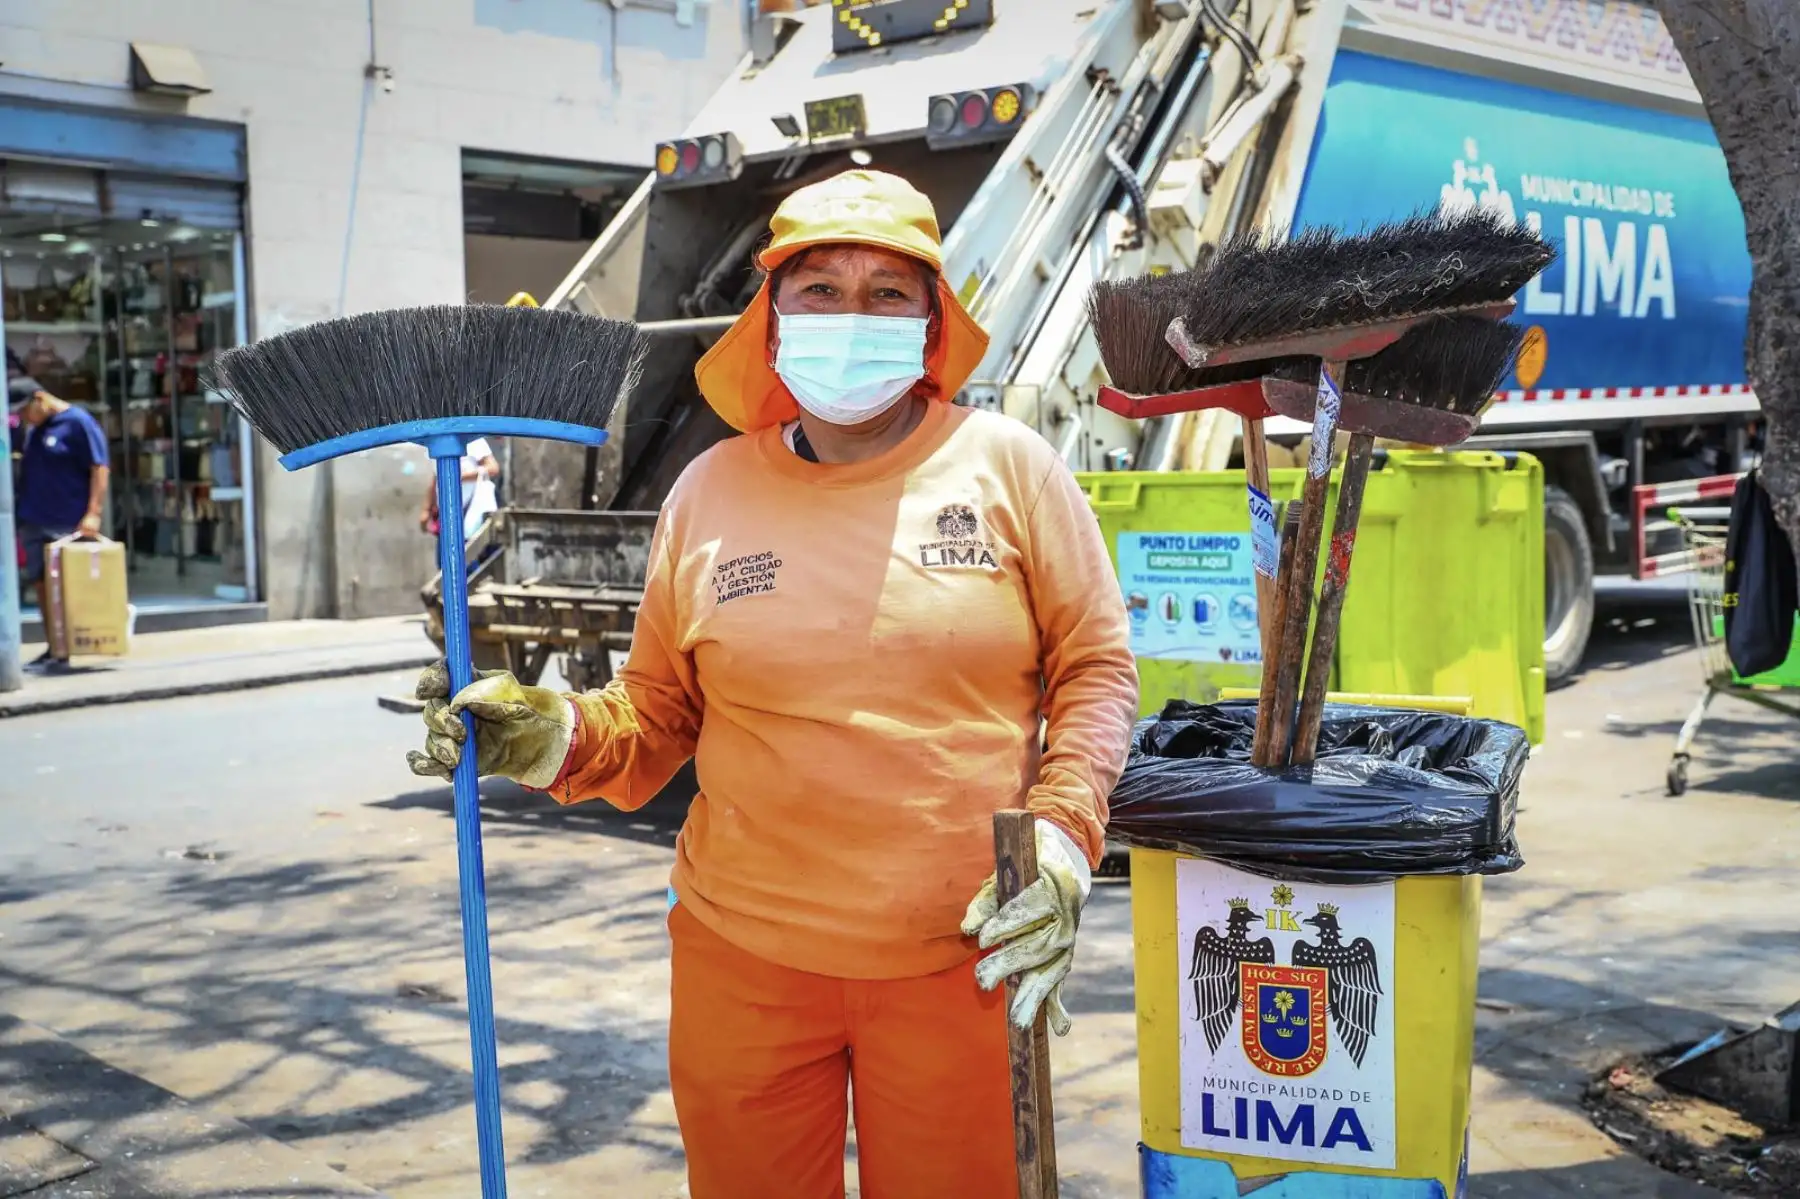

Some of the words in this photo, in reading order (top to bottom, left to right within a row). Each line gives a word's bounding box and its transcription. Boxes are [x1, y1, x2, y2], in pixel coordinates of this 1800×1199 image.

[1521, 174, 1652, 215] MUNICIPALIDAD
[1654, 190, 1676, 218] DE
[1524, 211, 1676, 319] LIMA
[1140, 535, 1186, 550] PUNTO
[1188, 537, 1240, 551] LIMPIO
[717, 551, 774, 573] SERVICIOS
[920, 547, 998, 568] LIMA
[711, 576, 718, 586] A
[721, 571, 735, 582] LA
[740, 559, 783, 576] CIUDAD
[716, 585, 723, 594] Y
[727, 571, 776, 590] GESTIÓN
[715, 582, 777, 605] AMBIENTAL
[1265, 908, 1303, 932] IK
[1247, 967, 1284, 982] HOC
[1244, 981, 1256, 1014] EST
[1203, 1075, 1343, 1101] MUNICIPALIDAD
[1350, 1090, 1372, 1103] DE
[1201, 1091, 1375, 1152] LIMA
